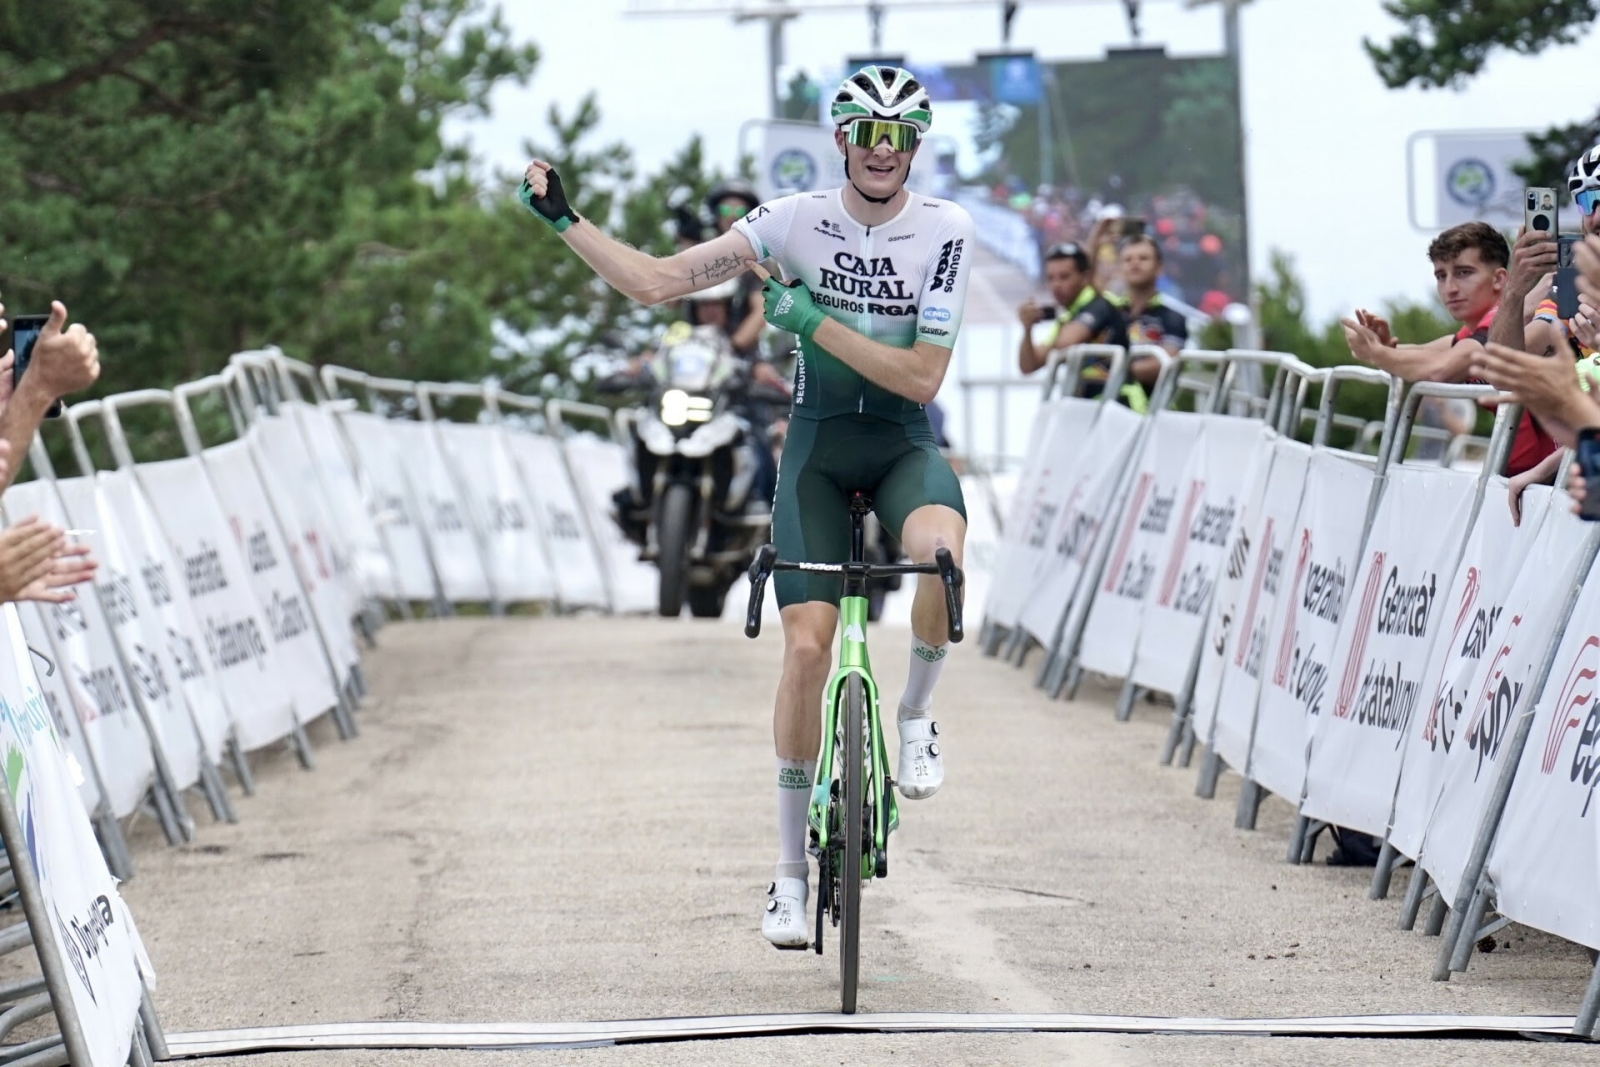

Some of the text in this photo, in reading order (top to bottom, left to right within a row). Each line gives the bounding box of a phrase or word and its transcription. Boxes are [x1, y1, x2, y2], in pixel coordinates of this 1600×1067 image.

[887, 233, 916, 242] GSPORT
[833, 251, 898, 278] CAJA
[930, 239, 954, 292] RGA
[943, 238, 964, 293] SEGUROS
[819, 267, 914, 300] RURAL
[810, 290, 865, 314] SEGUROS
[867, 302, 919, 316] RGA
[924, 310, 950, 320] KMC
[795, 349, 807, 405] SEGUROS
[778, 774, 810, 784] RURAL
[781, 767, 806, 776] CAJA
